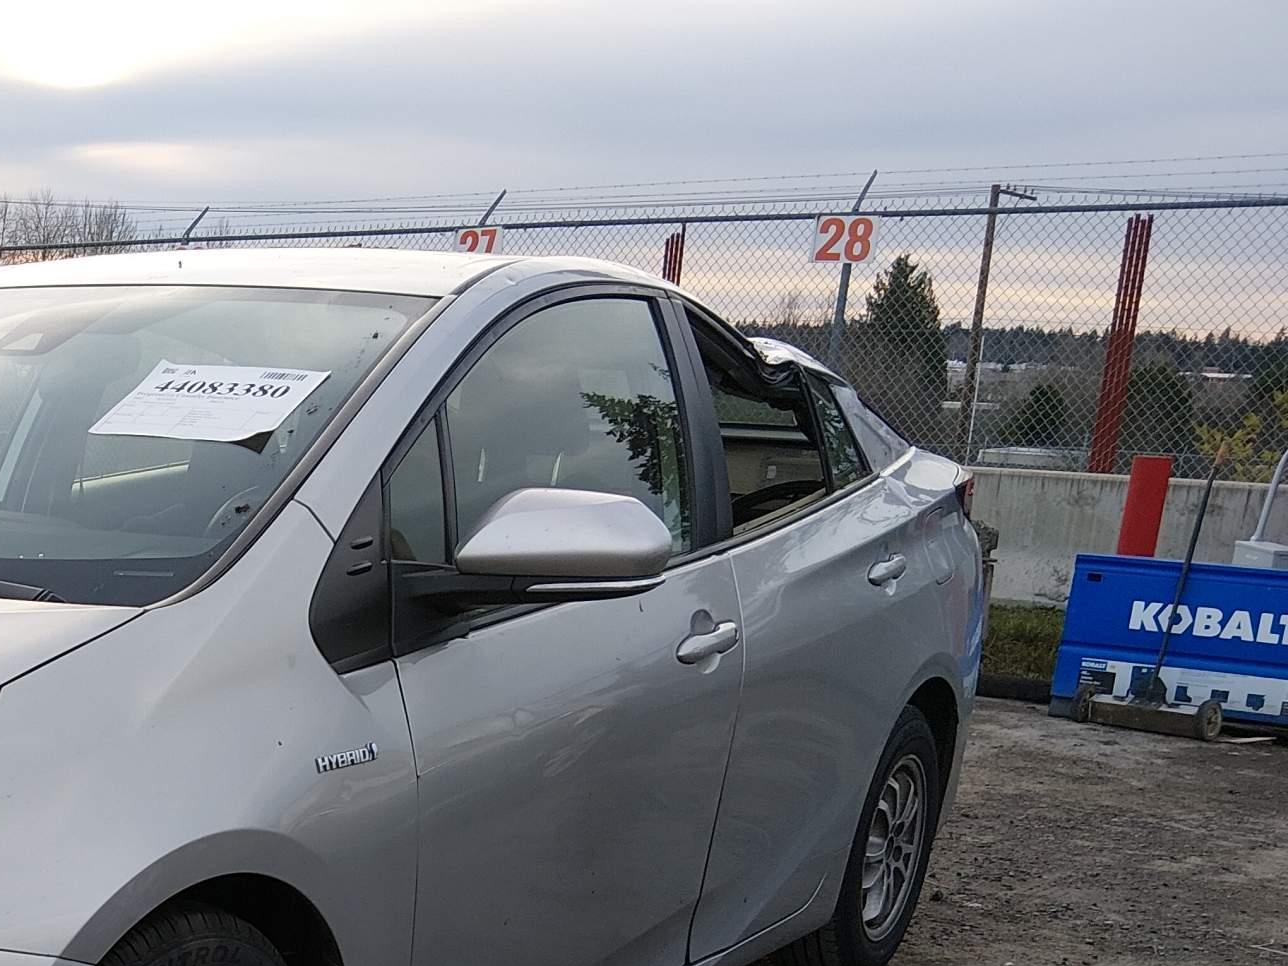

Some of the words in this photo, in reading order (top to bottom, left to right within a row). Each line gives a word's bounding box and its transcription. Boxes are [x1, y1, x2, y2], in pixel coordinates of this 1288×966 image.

[459, 229, 497, 253] 27
[816, 217, 872, 262] 28
[154, 379, 291, 399] 44083380
[315, 747, 371, 774] HYBRID
